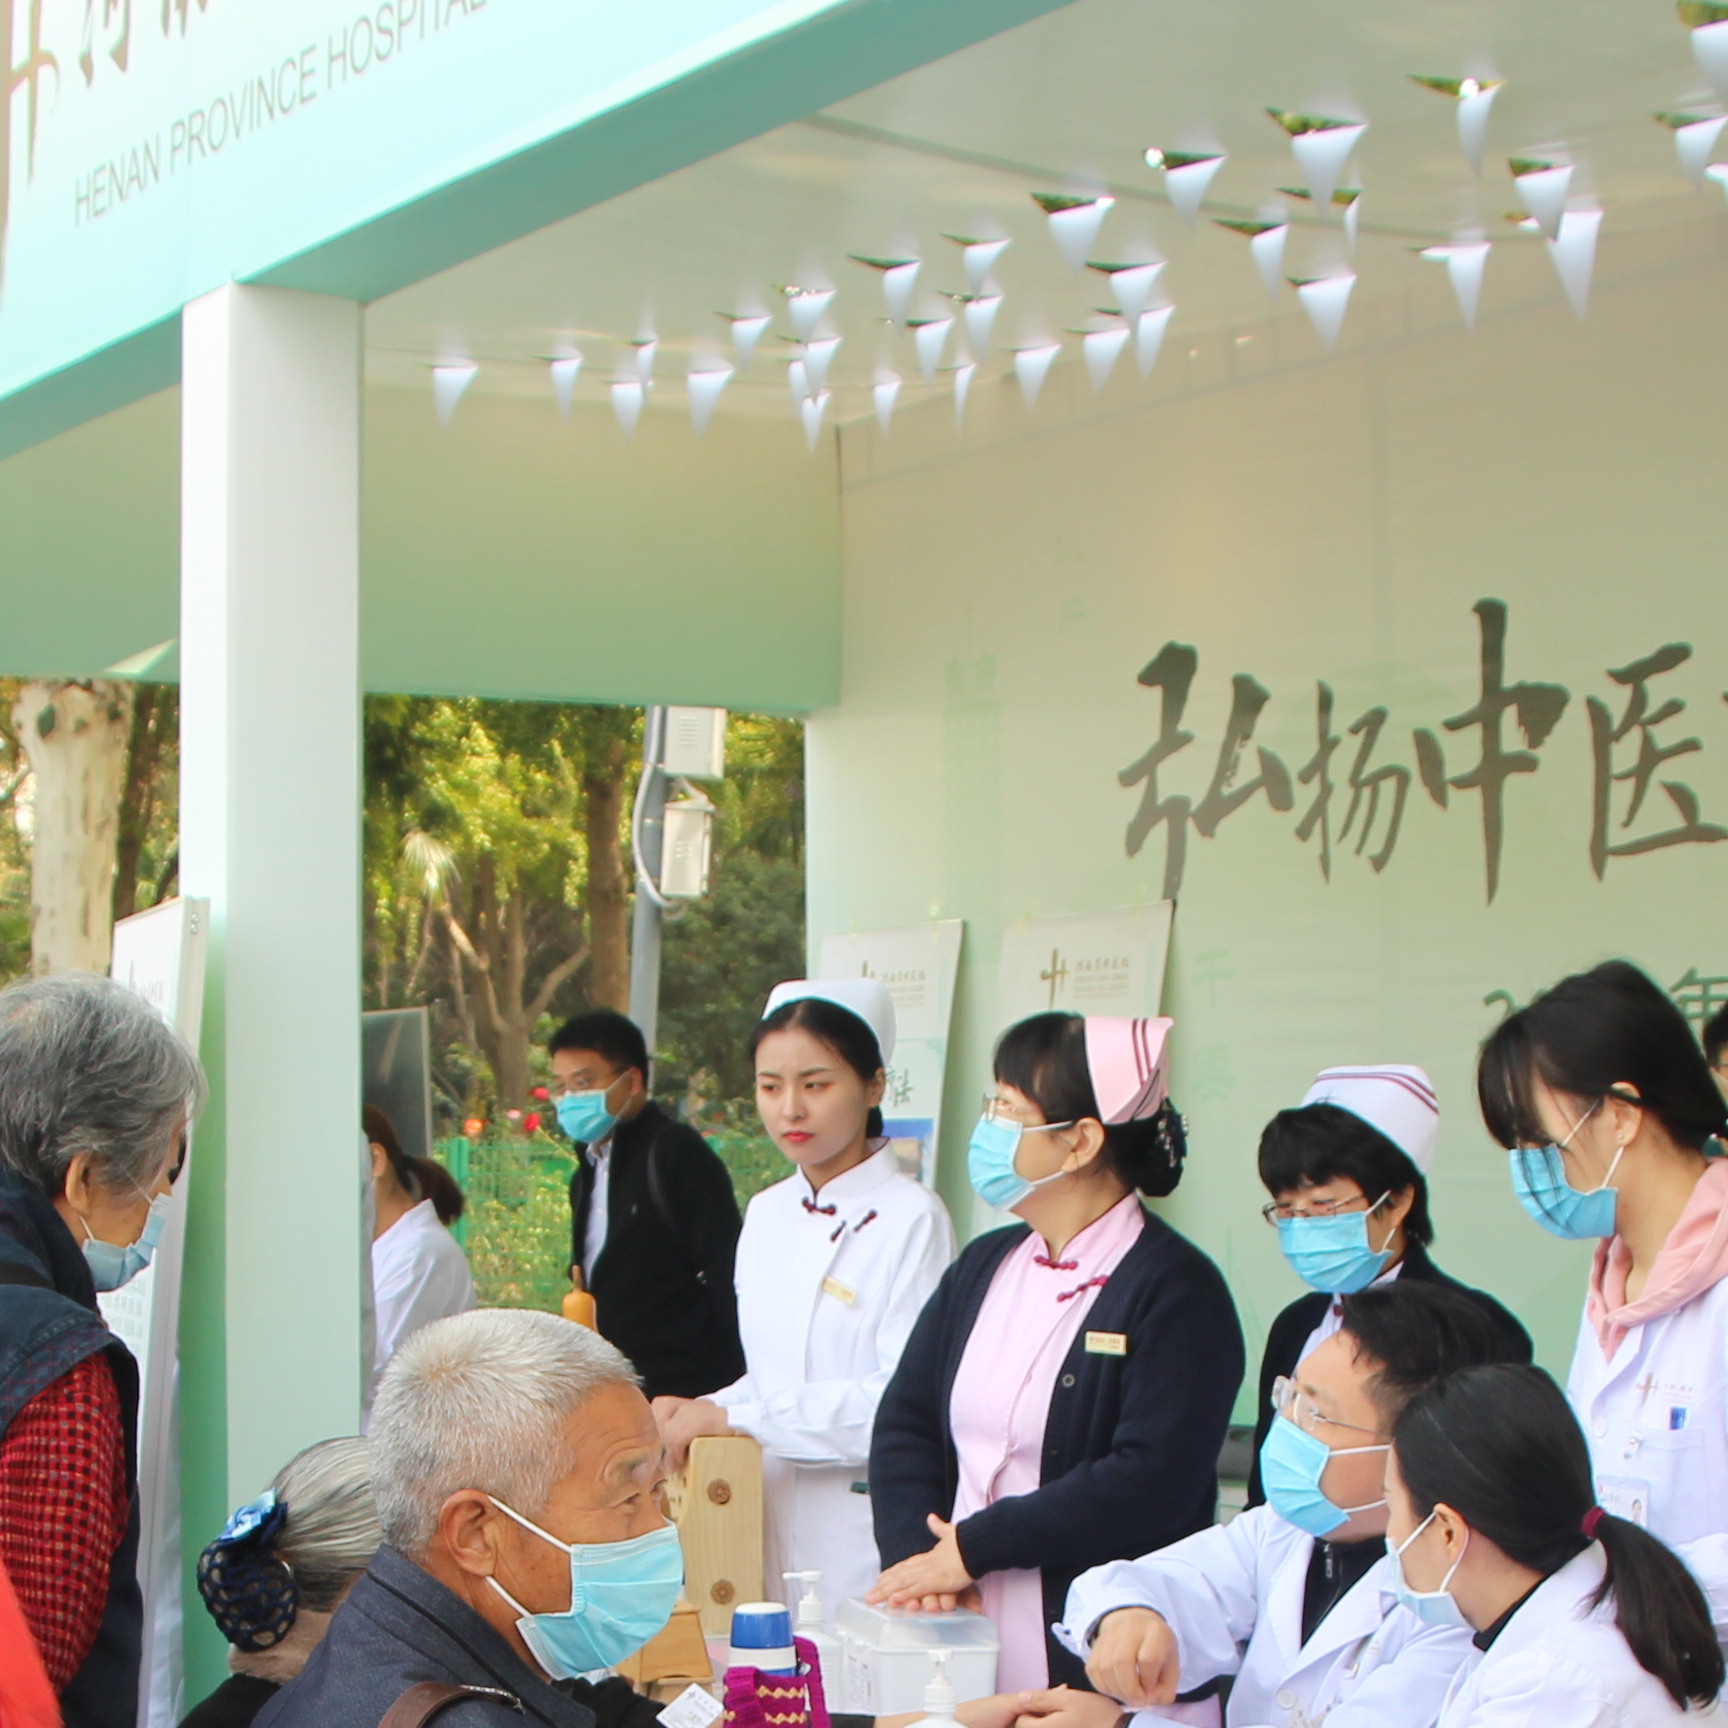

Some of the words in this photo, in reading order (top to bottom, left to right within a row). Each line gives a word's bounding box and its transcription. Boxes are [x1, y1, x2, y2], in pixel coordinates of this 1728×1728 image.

[74, 133, 161, 227] HENAN
[171, 43, 318, 174] PROVINCE
[326, 0, 485, 90] HOSPITA
